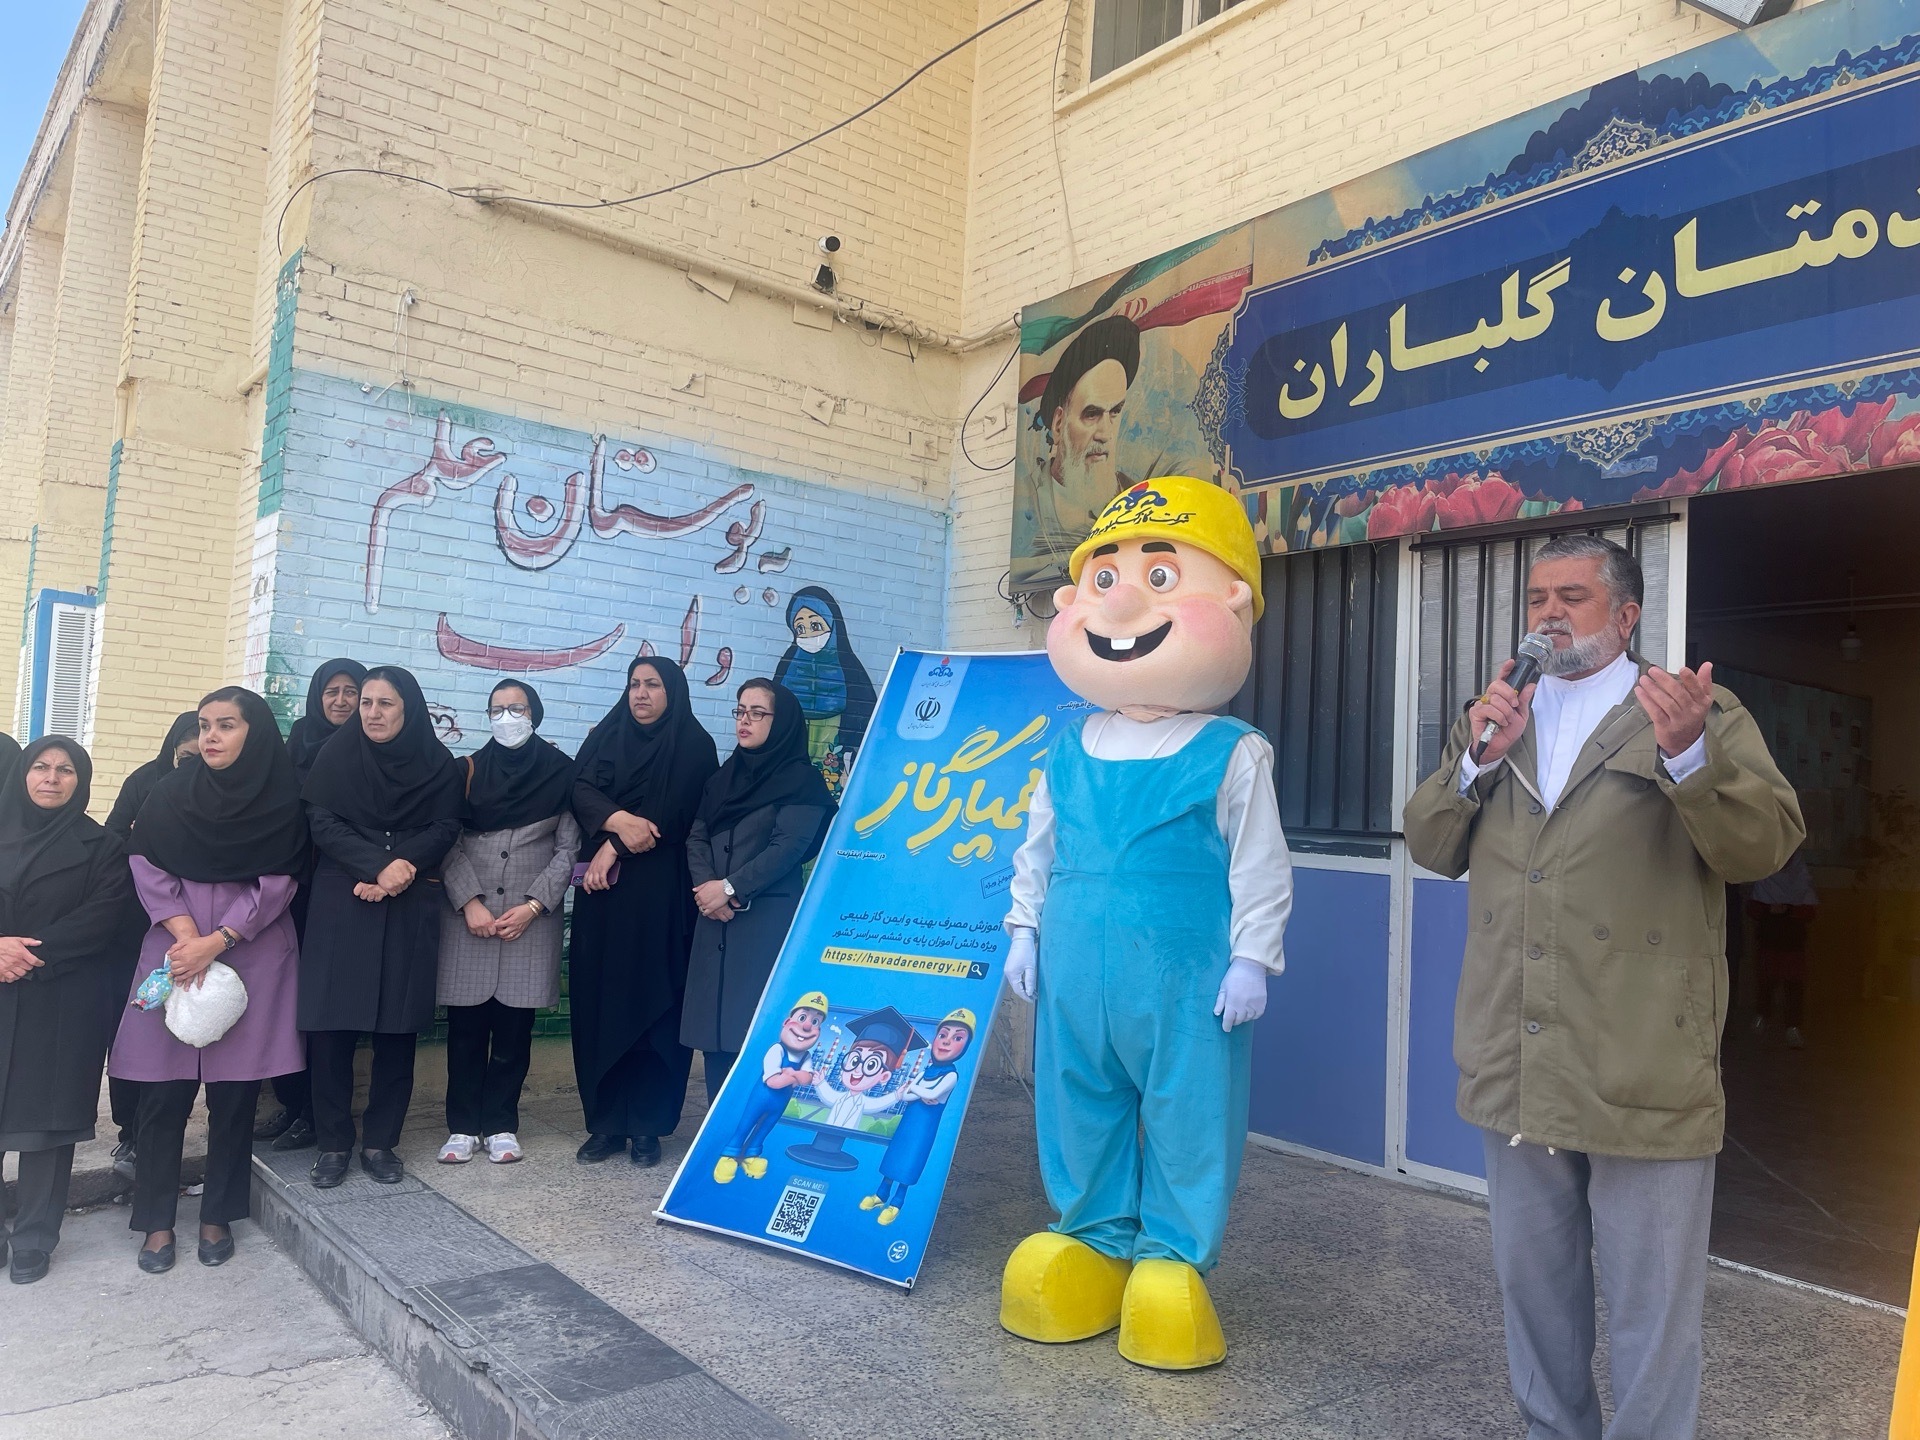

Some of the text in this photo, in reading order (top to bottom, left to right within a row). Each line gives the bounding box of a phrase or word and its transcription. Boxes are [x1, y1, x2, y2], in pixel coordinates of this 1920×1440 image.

[1277, 257, 1571, 420] گلباران
[365, 408, 507, 614] علم
[1149, 512, 1196, 526] شرکت
[839, 910, 1003, 934] آموزش مصرف بهینه و ایمن گاز طبیعی
[832, 927, 855, 939] کشور
[853, 929, 879, 941] سراسر
[878, 931, 902, 944] ششم
[912, 934, 927, 948] پایه
[928, 935, 956, 948] آموزان
[954, 938, 979, 950] دانش
[980, 940, 997, 953] ویژه
[824, 948, 967, 974] https://havadarenergy.ir
[793, 1178, 811, 1188] SCAN
